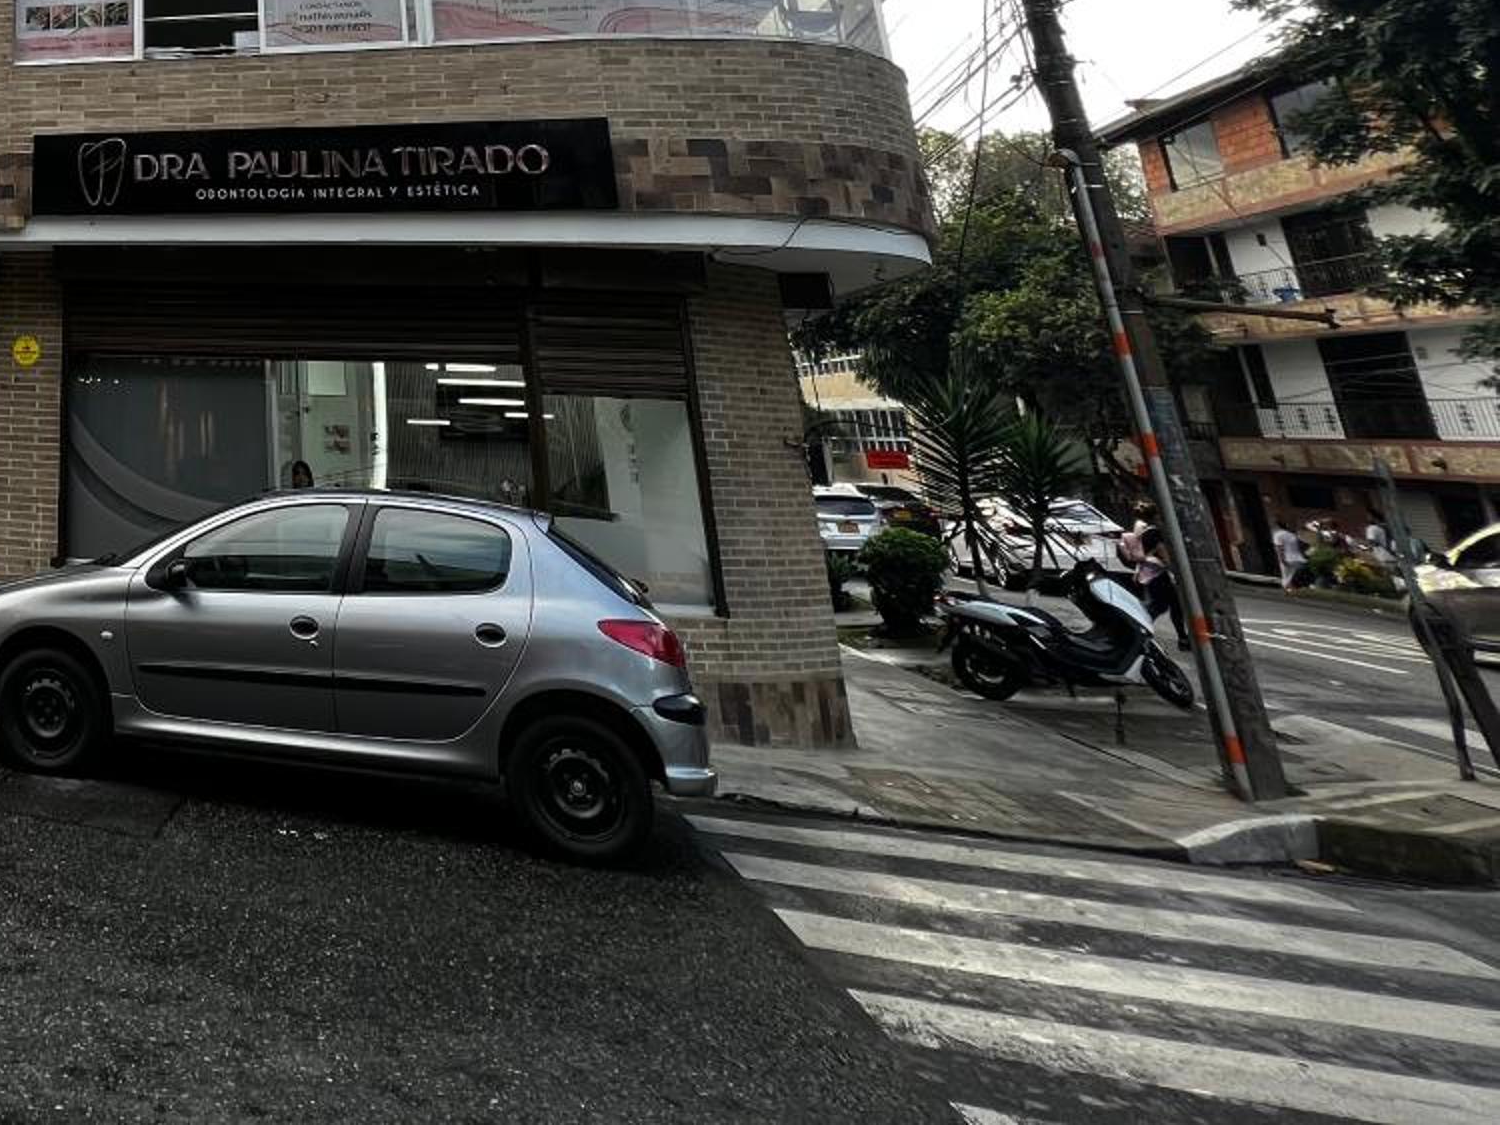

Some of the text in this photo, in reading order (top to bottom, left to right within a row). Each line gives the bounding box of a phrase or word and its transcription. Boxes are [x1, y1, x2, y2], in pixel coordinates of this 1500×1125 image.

[134, 143, 550, 181] DRA PAULINA TIRADO
[312, 186, 385, 200] INTEGRAL
[389, 186, 399, 197] Y
[407, 182, 481, 198] ESTÉTICA
